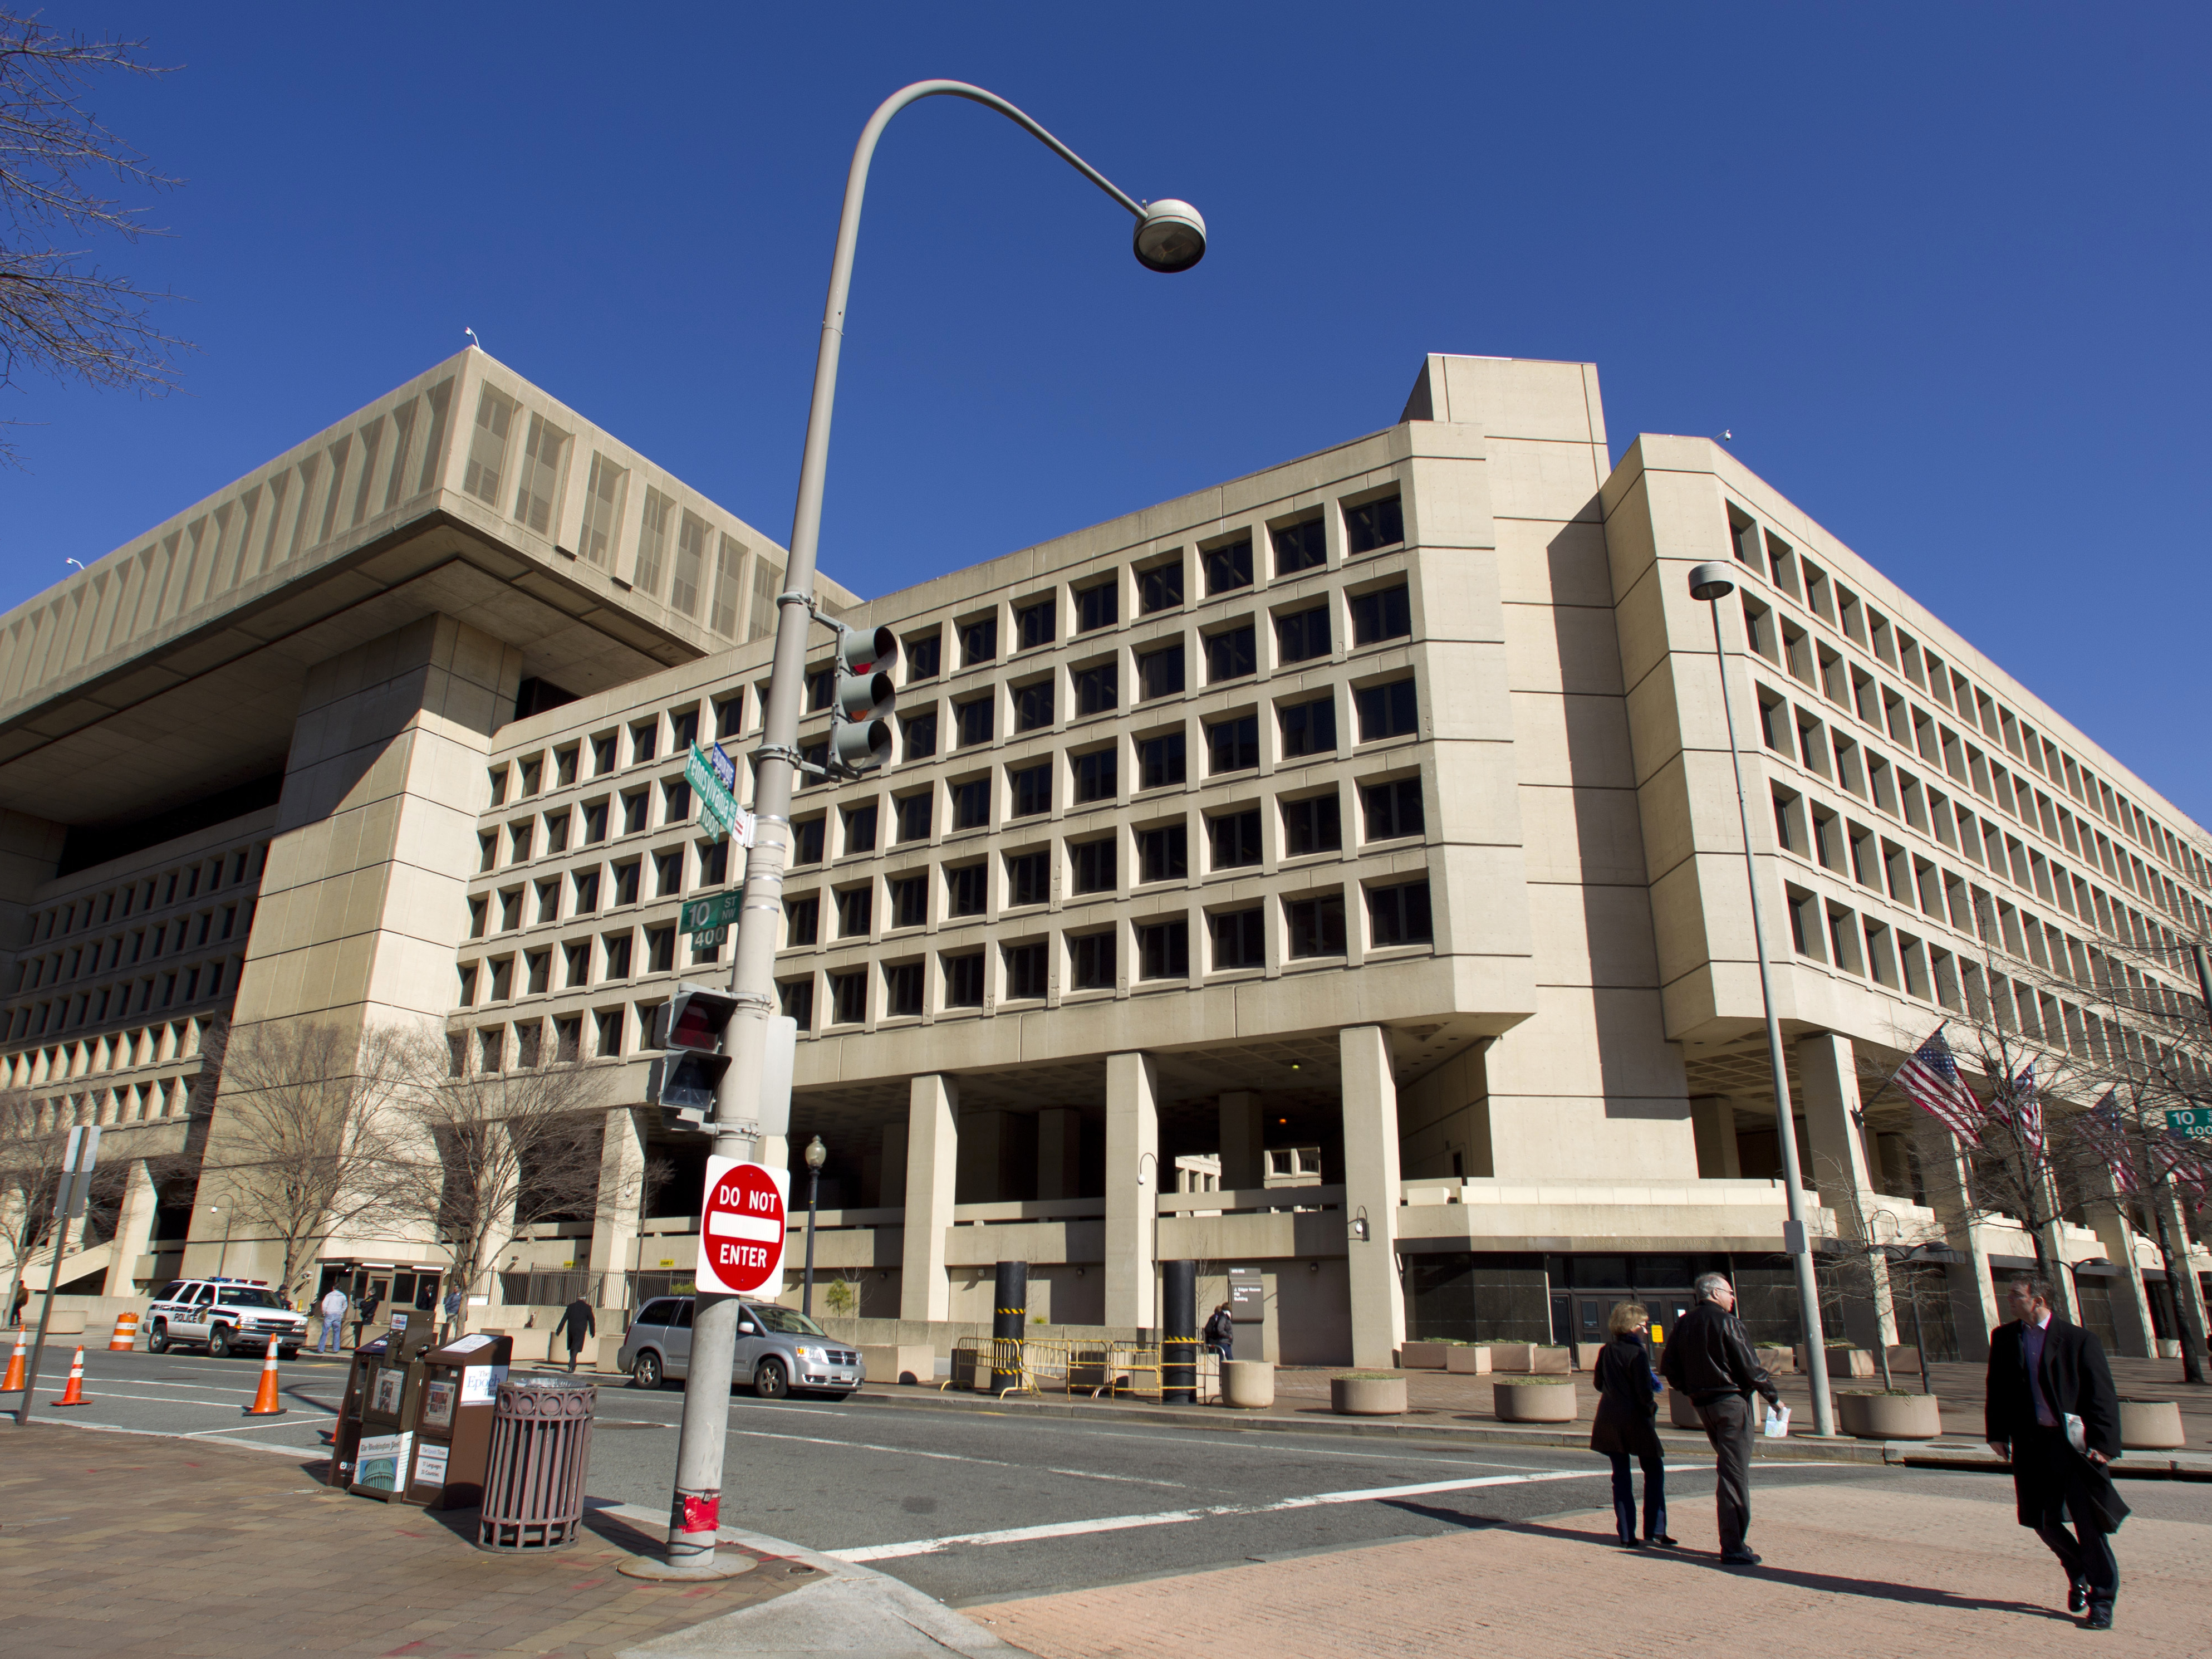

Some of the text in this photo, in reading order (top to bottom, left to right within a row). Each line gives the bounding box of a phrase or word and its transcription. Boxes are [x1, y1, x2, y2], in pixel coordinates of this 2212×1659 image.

[687, 744, 729, 819] Pennsylvania
[702, 806, 719, 838] 1000
[724, 896, 738, 908] ST
[688, 902, 710, 927] 10
[721, 908, 736, 920] NW
[694, 927, 725, 947] 400
[2171, 1111, 2196, 1125] 10
[2185, 1125, 2212, 1136] 400
[719, 1185, 777, 1212] DO NOT
[719, 1244, 767, 1268] ENTER
[174, 1313, 198, 1323] POLICE
[467, 1374, 501, 1391] Epoch
[484, 1388, 497, 1396] Tim
[368, 1442, 390, 1451] Washington
[390, 1441, 400, 1451] Post
